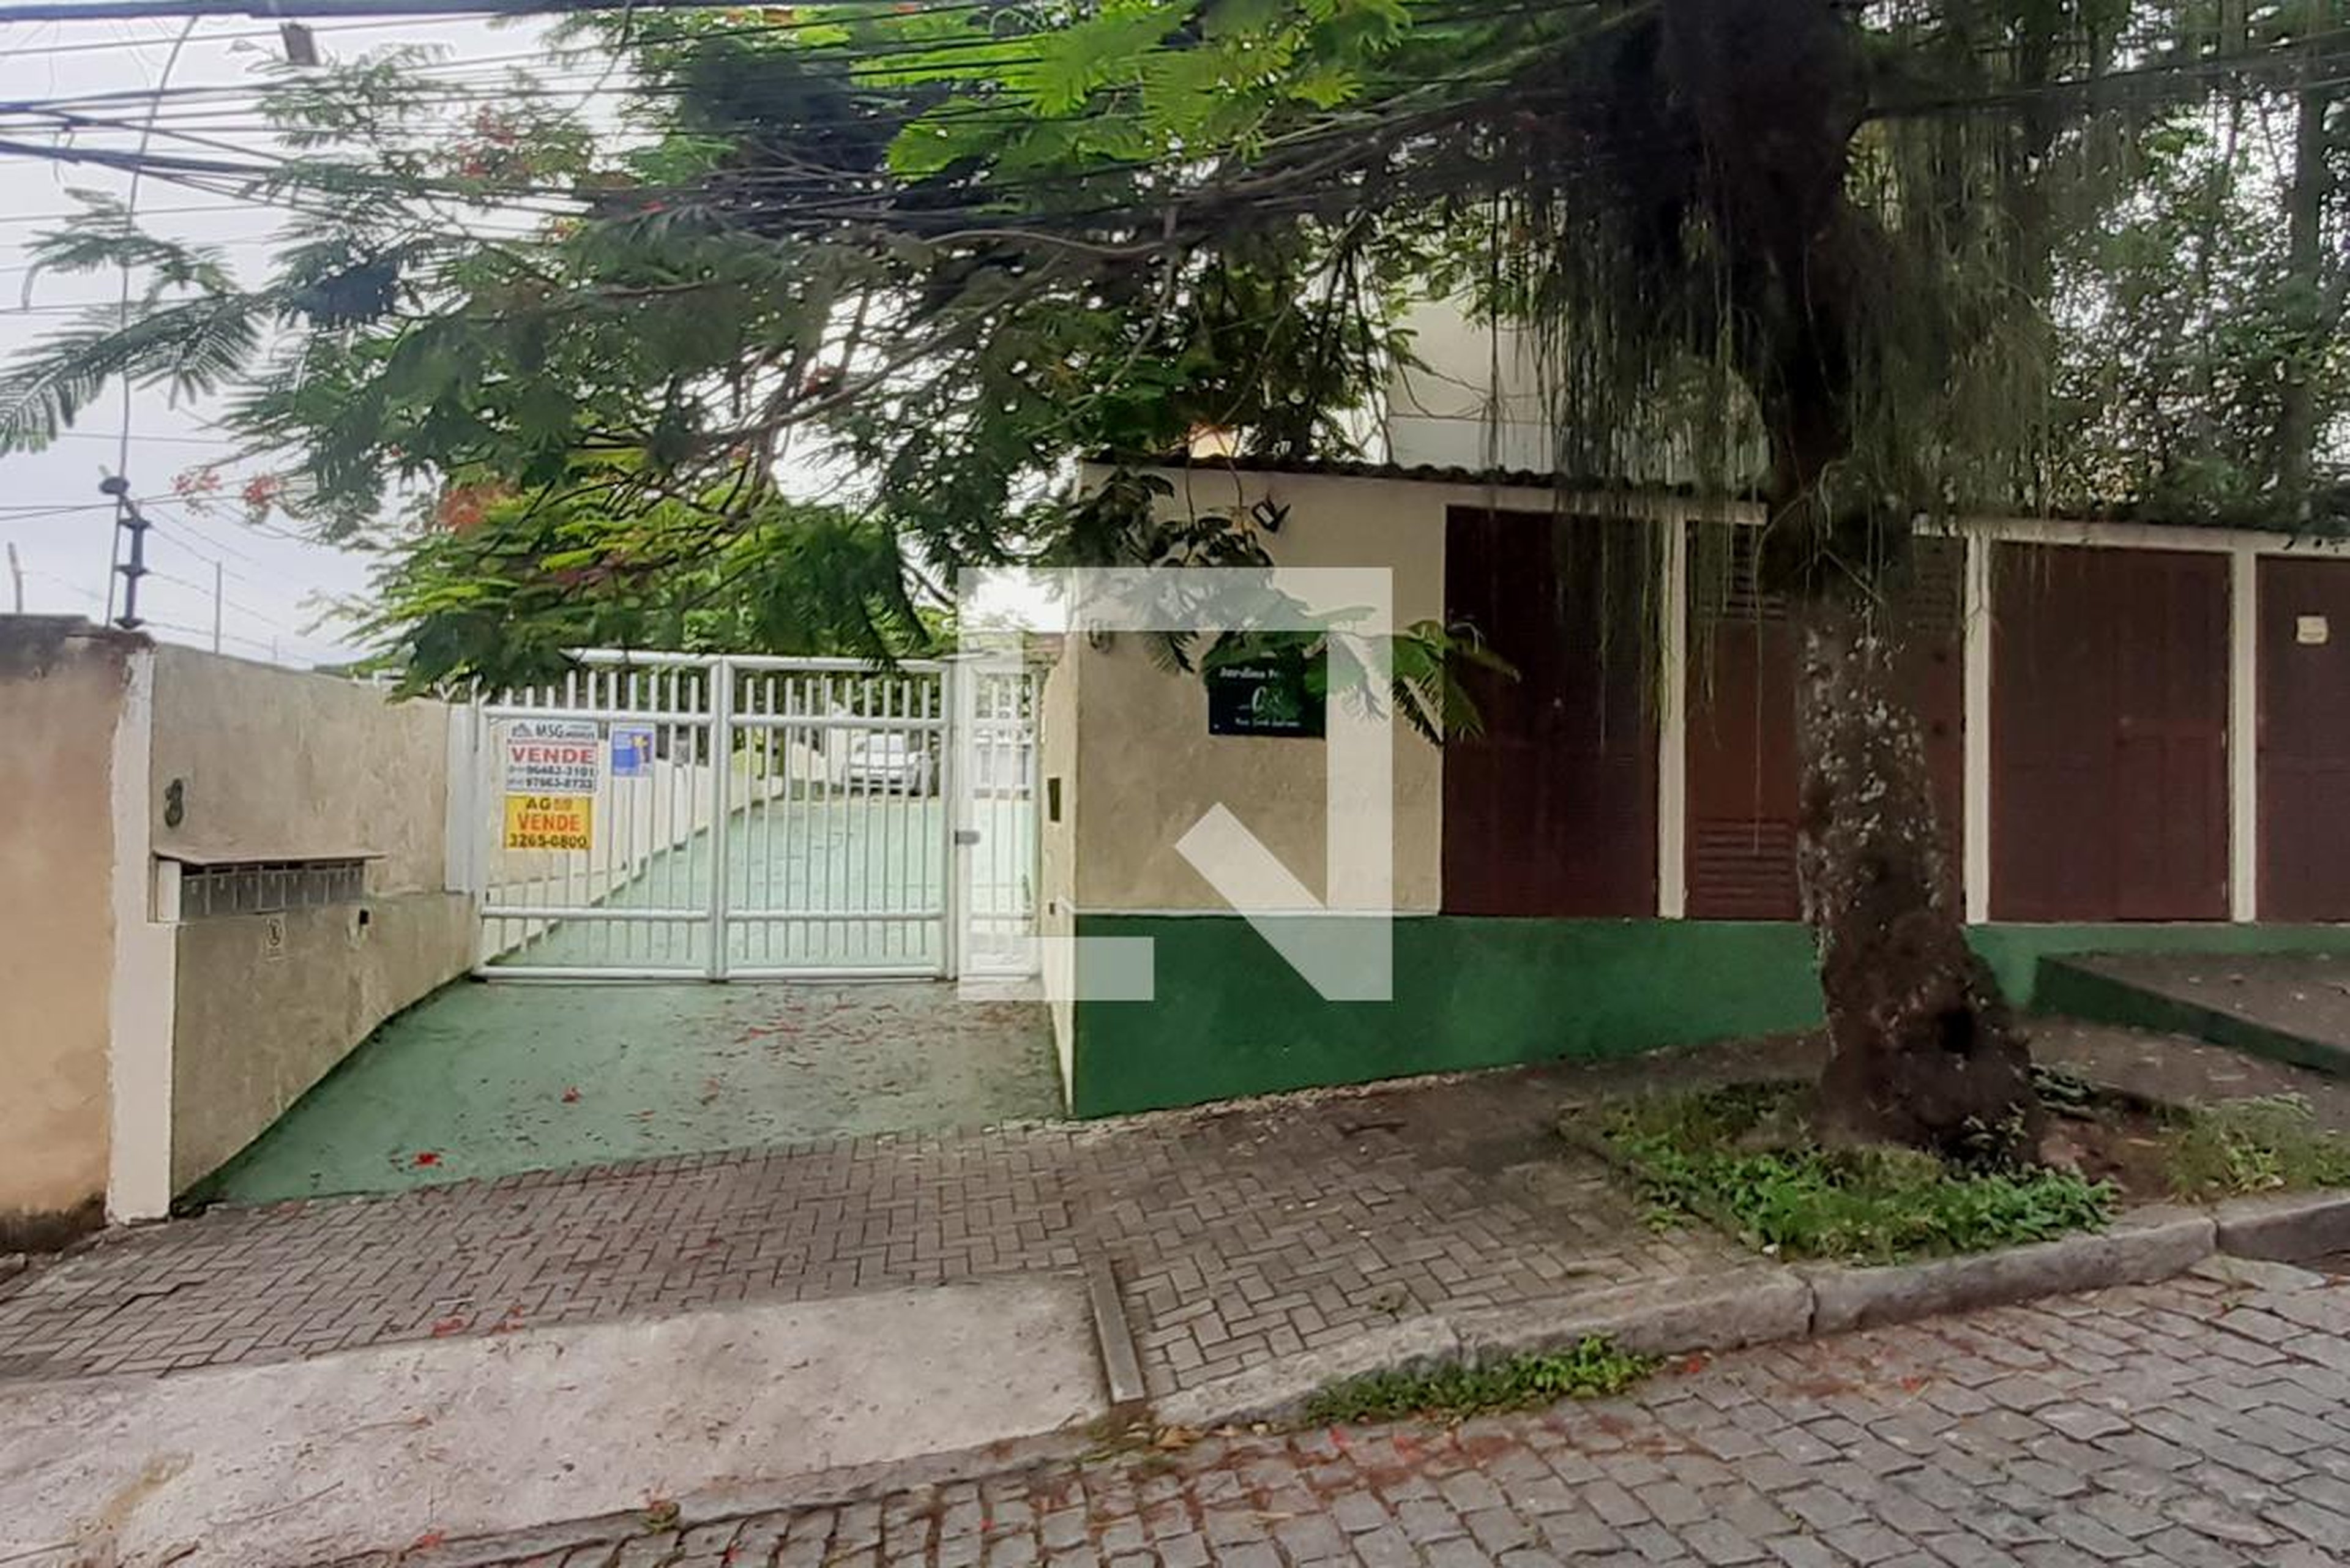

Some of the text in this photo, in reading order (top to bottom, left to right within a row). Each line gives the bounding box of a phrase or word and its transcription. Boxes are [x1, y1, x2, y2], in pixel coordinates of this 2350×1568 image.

[535, 724, 563, 737] MSG
[511, 747, 594, 764] VENDE
[517, 813, 581, 831] VENDE
